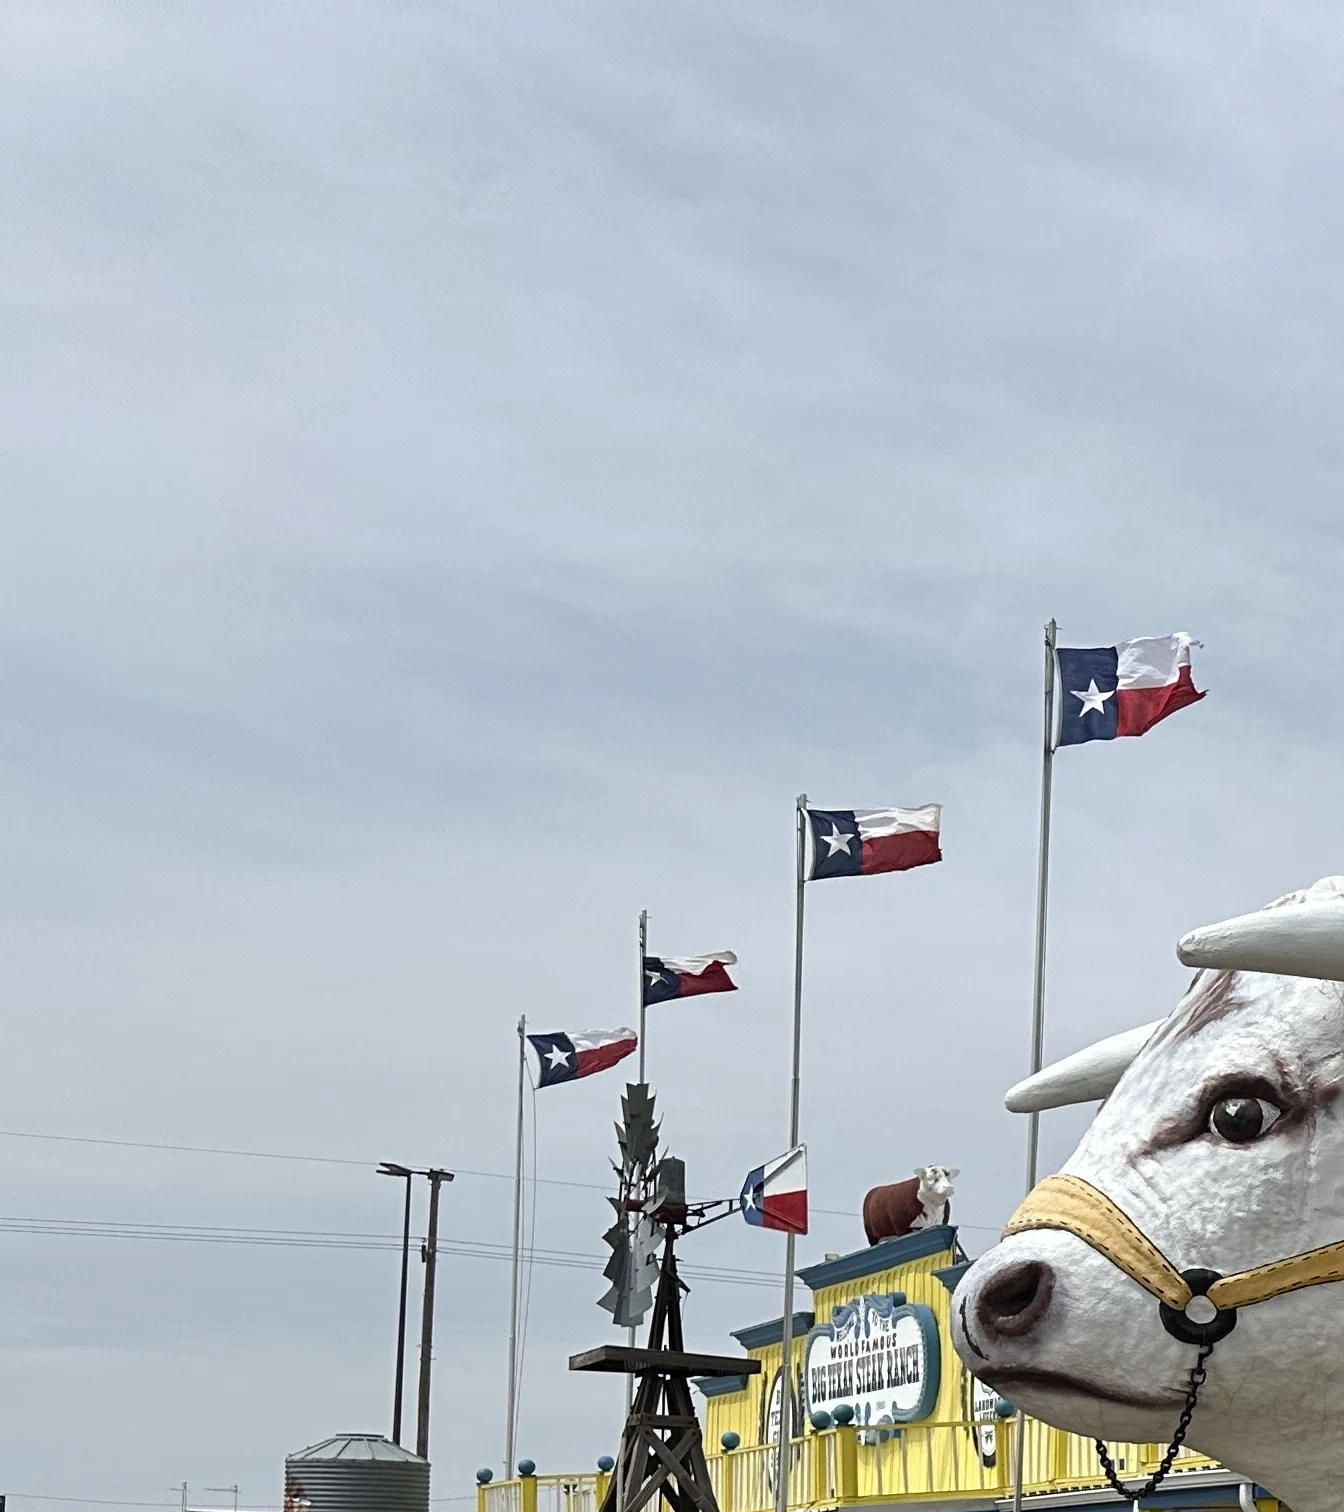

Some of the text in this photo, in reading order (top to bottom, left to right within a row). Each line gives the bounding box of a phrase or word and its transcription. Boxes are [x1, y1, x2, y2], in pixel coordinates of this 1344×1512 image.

[830, 1332, 898, 1360] WORLD FAMOUS
[811, 1343, 920, 1404] BIG TEXAN STEAK RANCH
